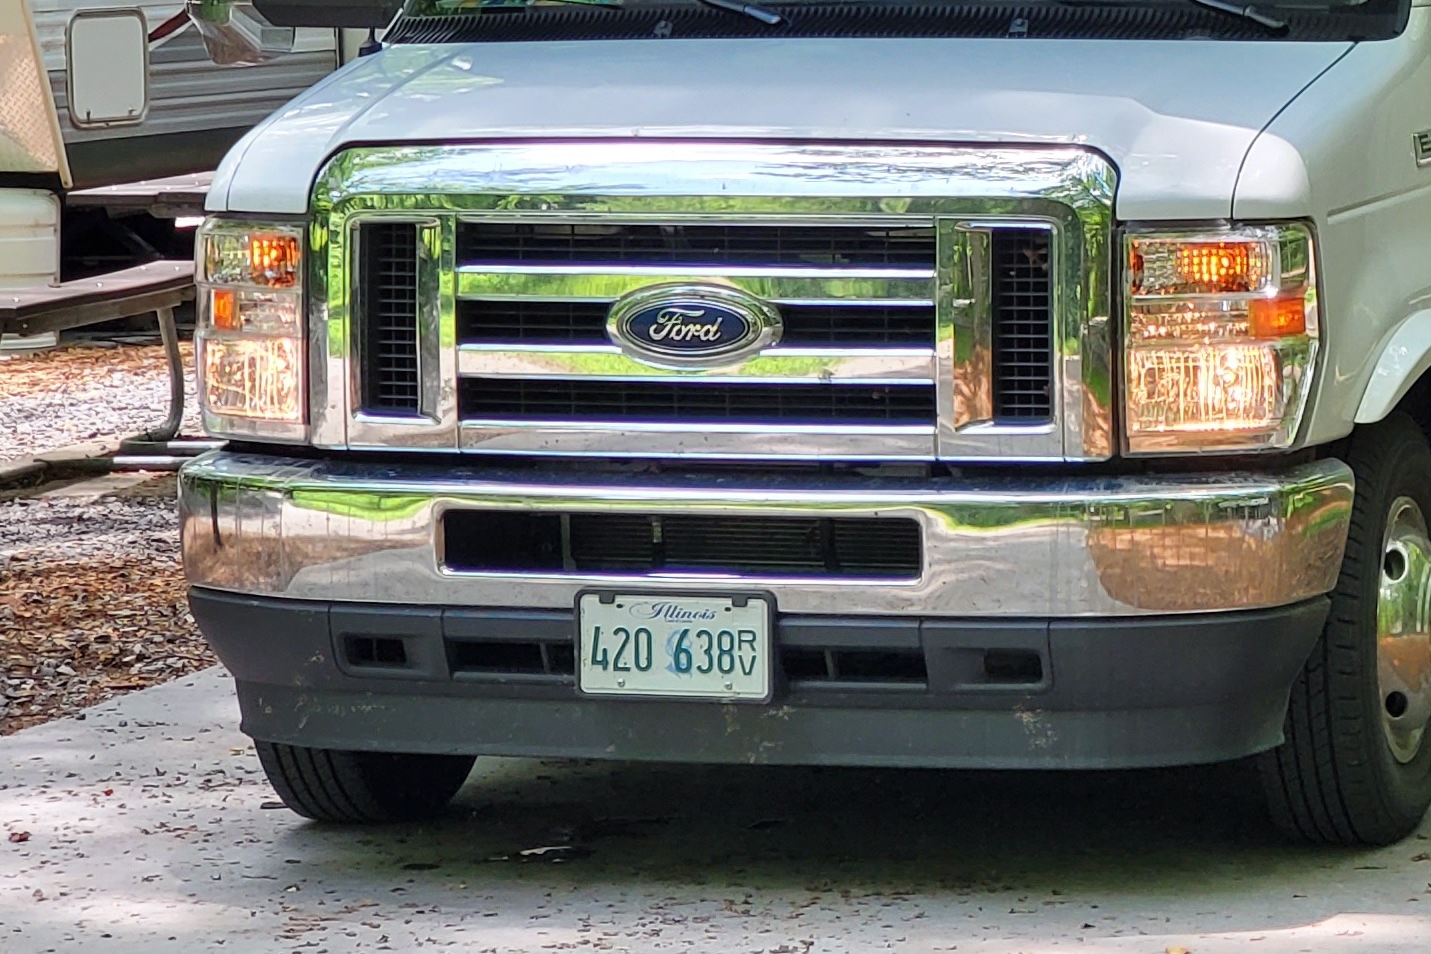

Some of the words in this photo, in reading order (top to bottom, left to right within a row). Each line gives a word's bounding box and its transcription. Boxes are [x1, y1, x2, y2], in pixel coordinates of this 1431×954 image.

[649, 307, 723, 342] Ford
[629, 601, 718, 621] Illinois
[591, 625, 653, 673] 420
[673, 628, 736, 675] 638
